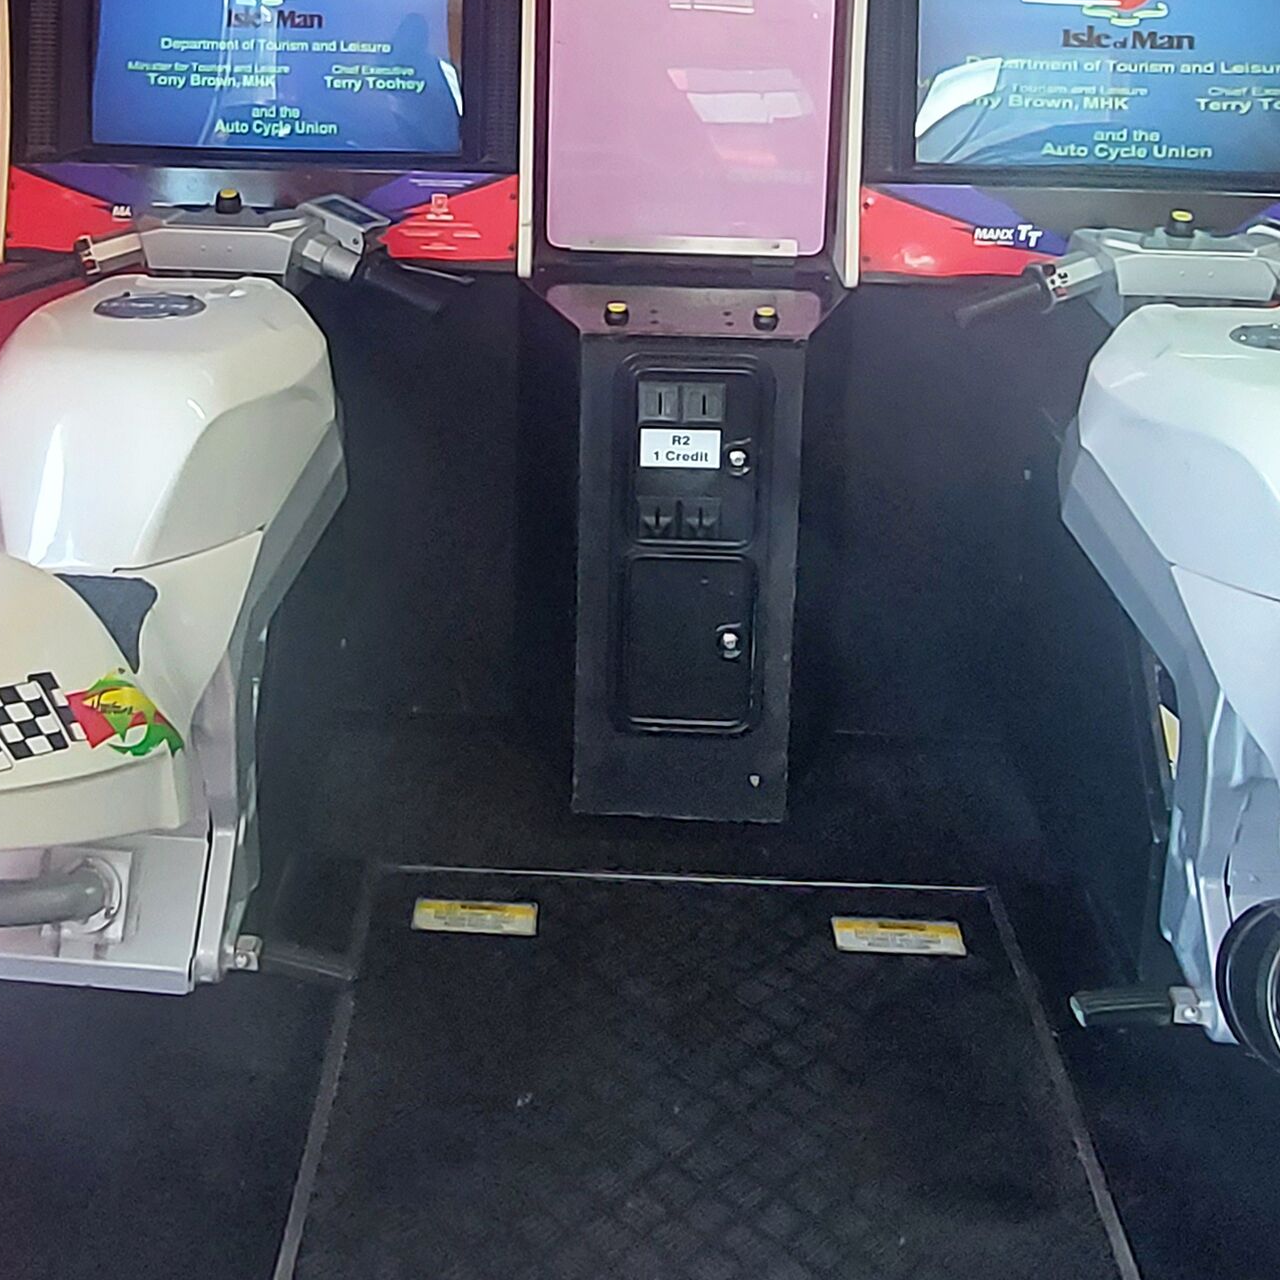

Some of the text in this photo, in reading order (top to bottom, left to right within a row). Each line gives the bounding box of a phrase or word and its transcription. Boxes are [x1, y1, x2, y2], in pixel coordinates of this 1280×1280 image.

[276, 10, 323, 28] Man
[160, 37, 392, 53] Department of Tourism and Leisure
[1062, 25, 1112, 49] Isle
[1131, 30, 1195, 51] Man
[966, 55, 1078, 72] Dartment
[1083, 59, 1101, 71] of
[1108, 59, 1176, 73] Tourism
[1179, 61, 1215, 74] and
[147, 72, 186, 89] Tony
[190, 73, 241, 88] Brown,
[324, 75, 426, 94] Terry Toohey
[1008, 95, 1079, 111] Brown,
[1083, 96, 1129, 111] MHK
[1195, 98, 1252, 115] Terry
[251, 105, 301, 120] and the
[215, 119, 250, 135] Auto
[295, 121, 338, 136] Union
[1093, 128, 1161, 143] and the
[1041, 142, 1213, 161] Auto Cycle Union
[974, 223, 1044, 248] MANX TT
[671, 435, 691, 446] R2
[653, 450, 709, 463] 1 Credit
